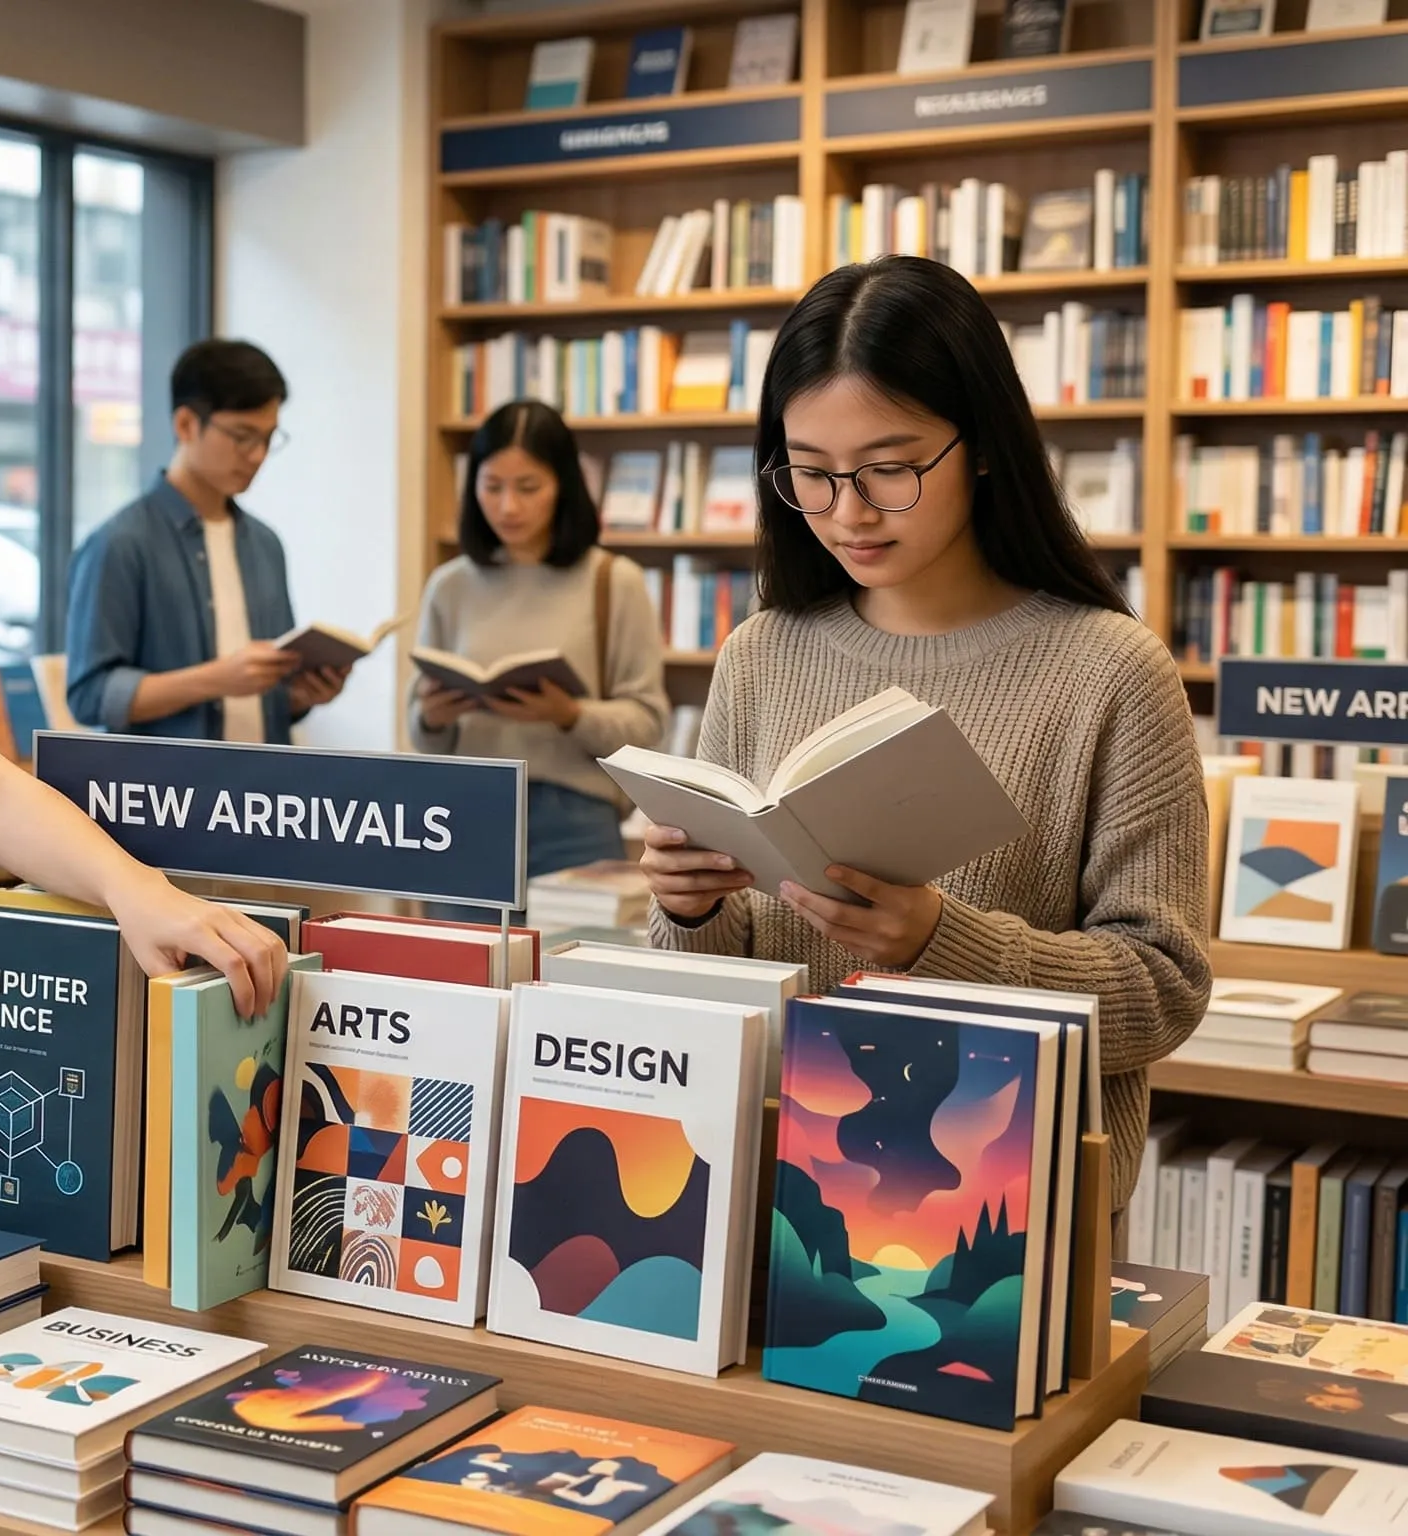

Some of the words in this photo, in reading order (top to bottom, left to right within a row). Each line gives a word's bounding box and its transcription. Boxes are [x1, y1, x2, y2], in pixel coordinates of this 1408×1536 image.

[1257, 686, 1341, 717] NEW
[88, 780, 194, 828] NEW
[206, 790, 452, 851] ARRIVALS
[310, 1001, 411, 1045] ARTS
[534, 1032, 689, 1087] DESIGN
[43, 1320, 203, 1358] BUSINESS
